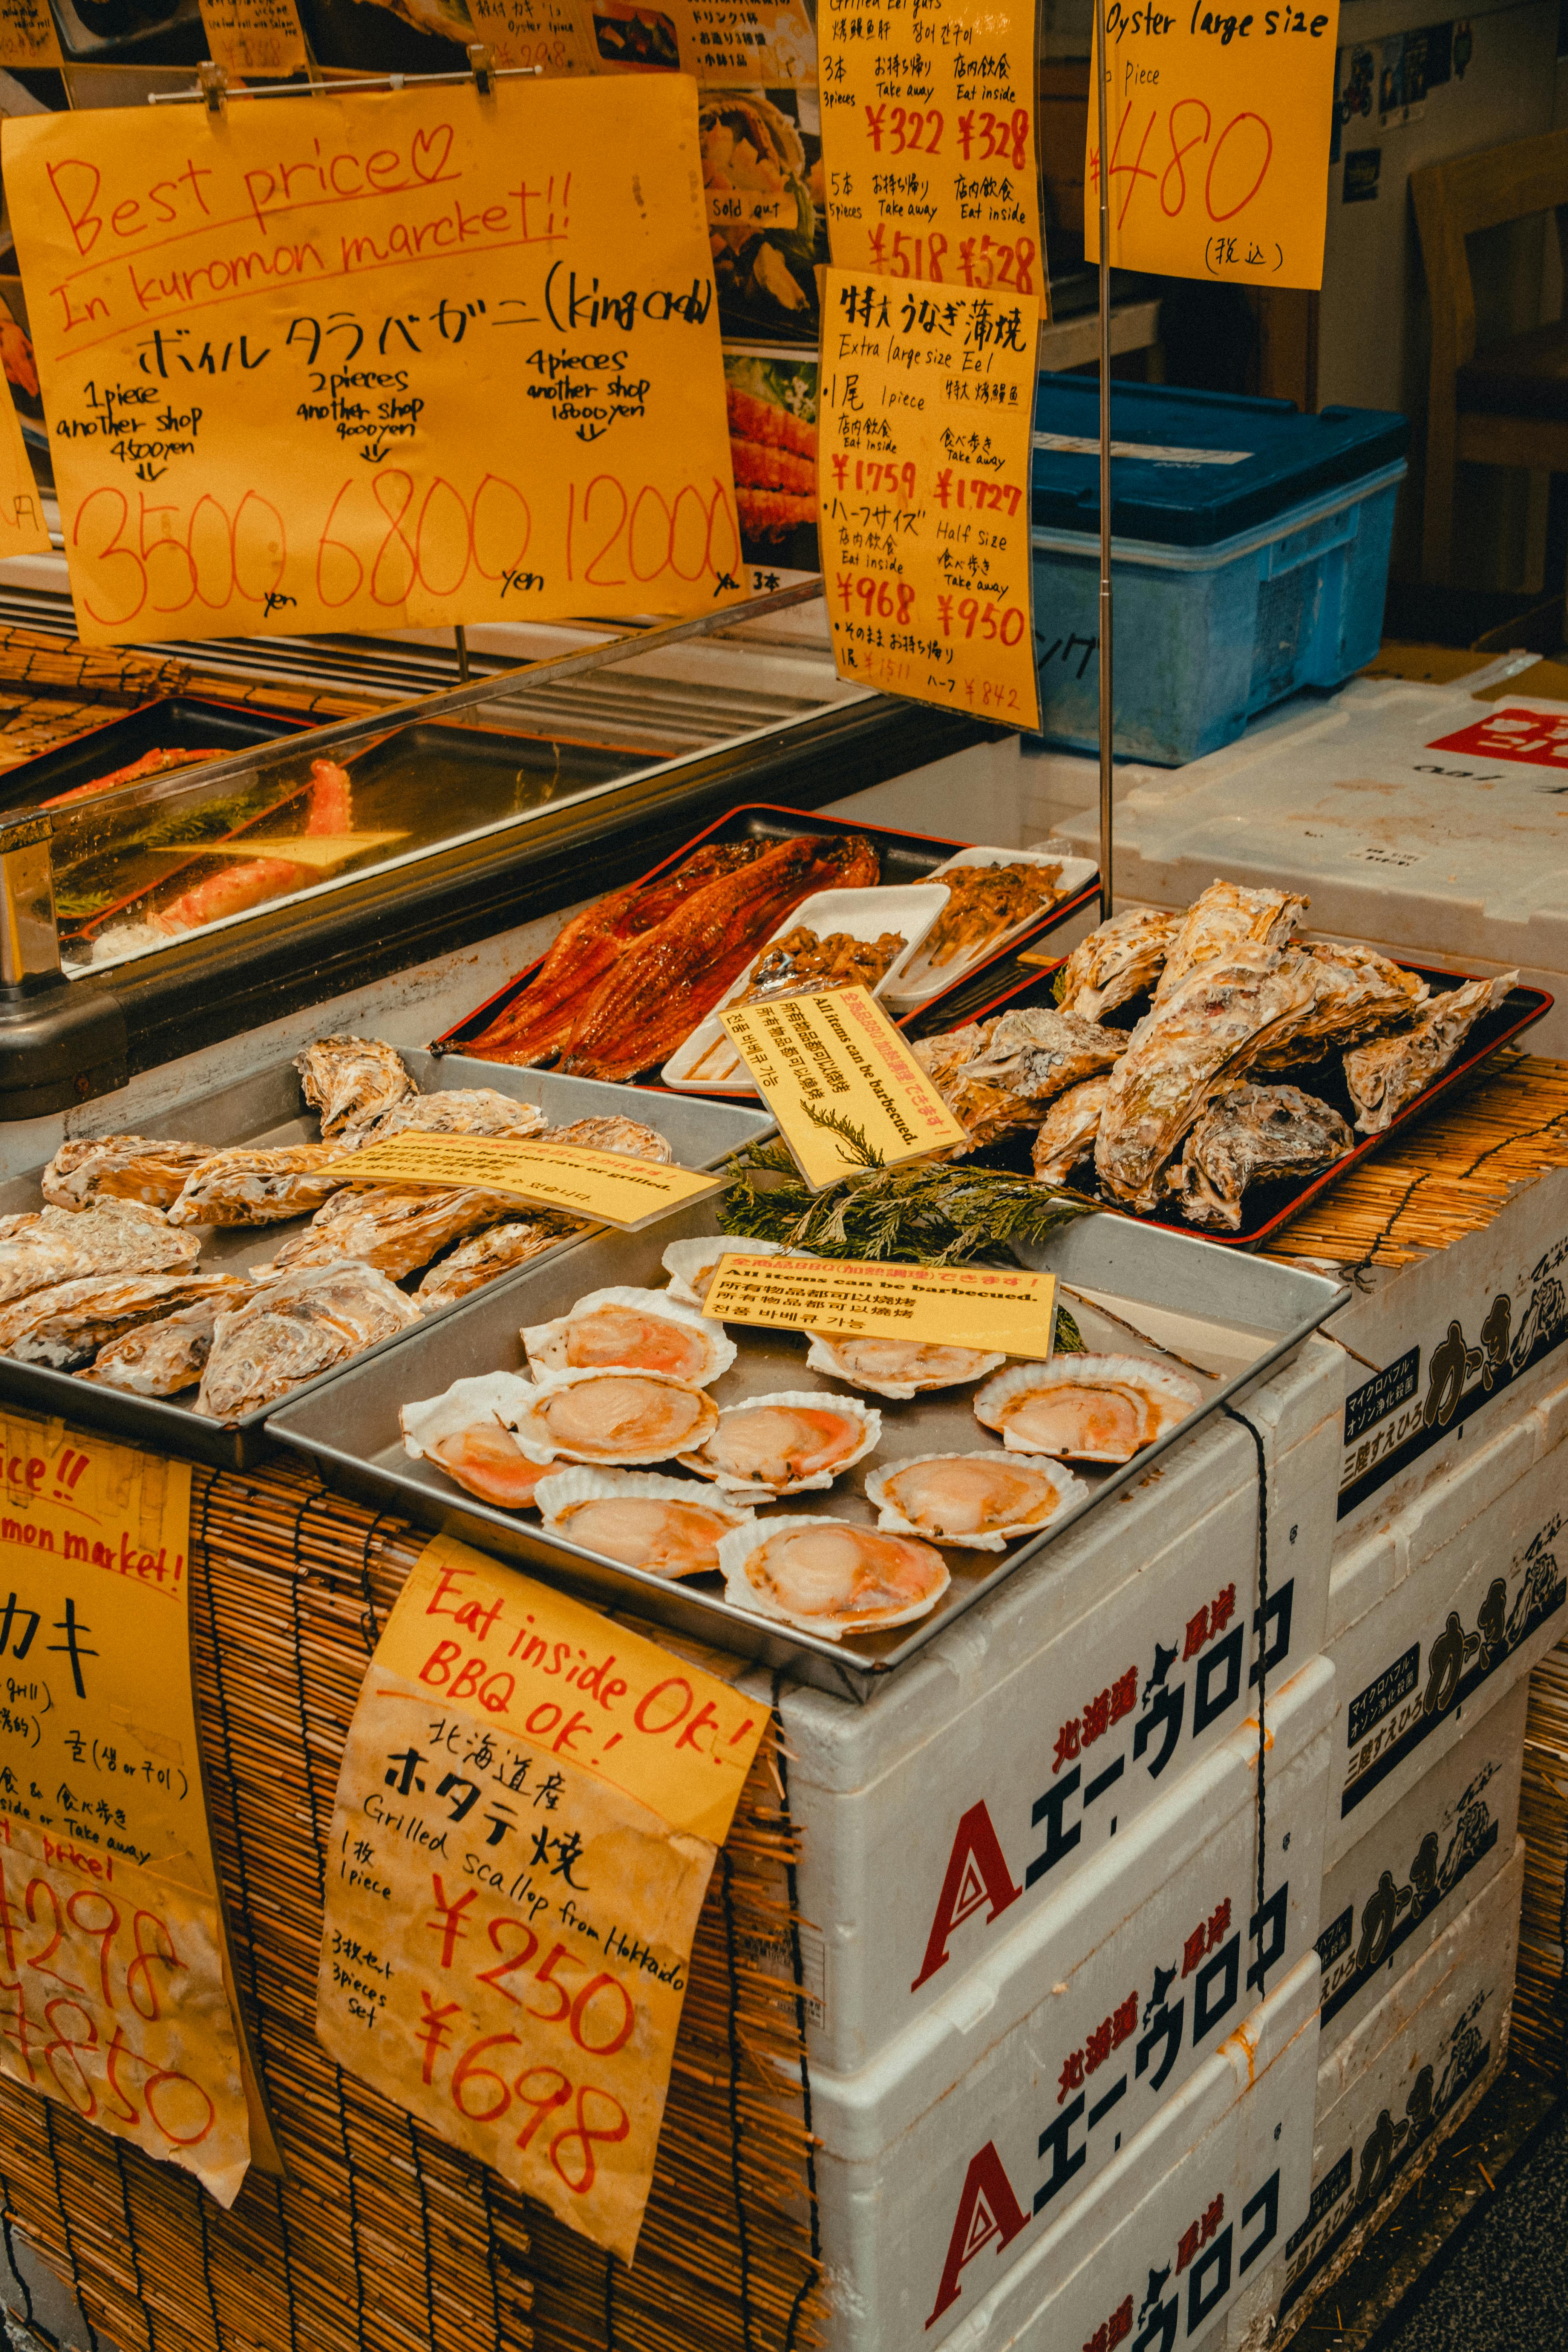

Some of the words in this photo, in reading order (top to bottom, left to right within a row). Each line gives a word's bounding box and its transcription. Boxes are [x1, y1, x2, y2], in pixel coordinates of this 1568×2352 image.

[508, 20, 540, 37] Oyster
[913, 21, 935, 43] 장어
[1106, 1, 1176, 44] Oyster
[1190, 0, 1254, 45] large
[1266, 5, 1329, 38] size
[823, 55, 846, 82] 3本
[875, 54, 931, 78] お持ち帰り
[954, 53, 1011, 79] 店内飲食
[824, 91, 856, 109] 3pieces
[876, 81, 902, 98] Take
[906, 87, 934, 104] away
[957, 85, 977, 100] Eat
[982, 86, 1015, 103] inside
[865, 103, 944, 155] ¥322
[957, 109, 1029, 170] ¥328
[831, 172, 853, 196] 5本
[1089, 98, 1272, 231] ¥480
[46, 159, 212, 256] Best
[244, 138, 400, 235] price
[872, 174, 929, 201] お持ち帰り
[954, 174, 1014, 201] 店内飲食
[712, 198, 741, 217] Sold
[752, 201, 780, 219] out
[829, 202, 862, 221] 5pieces
[878, 200, 903, 217] Take
[908, 204, 938, 223] away
[961, 204, 981, 219] Eat
[989, 204, 1026, 224] inside
[868, 223, 948, 283] ¥518
[957, 234, 1035, 295] ¥528
[1205, 236, 1283, 275] (税込)
[49, 282, 110, 332] In
[129, 243, 324, 310] kuromon
[137, 330, 271, 378] ボイル
[286, 299, 540, 365] タラバガニ
[545, 260, 639, 332] (king
[839, 334, 879, 360] Extra
[888, 335, 920, 369] large
[928, 349, 952, 367] size
[963, 351, 993, 373] Eel
[527, 375, 597, 399] another
[606, 375, 650, 402] shop
[56, 414, 146, 438] another
[157, 406, 203, 436] shop
[297, 397, 370, 424] another
[378, 397, 424, 425] shop
[839, 413, 891, 438] 店内飲食
[844, 438, 861, 448] Eat
[867, 439, 897, 454] inside
[940, 427, 991, 455] 食べ歩き
[948, 450, 970, 463] Take
[977, 456, 1006, 471] away
[316, 469, 531, 608] 6800
[502, 571, 543, 598] yen
[568, 475, 739, 586] 12000
[831, 499, 926, 536] ハーフサイズ
[937, 521, 971, 542] Half
[74, 487, 286, 625] 3500
[264, 591, 297, 617] yen
[839, 527, 897, 556] 店内飲食
[753, 571, 780, 592] 3本
[842, 551, 859, 565] Eat
[867, 557, 903, 574] inside
[938, 548, 989, 577] 食べ歩き
[837, 572, 915, 625] ¥968
[944, 574, 971, 590] Take
[977, 581, 1008, 602] away
[937, 594, 1024, 646] ¥950
[928, 675, 955, 693] ハーフ
[740, 1033, 768, 1064] 바베큐
[760, 1065, 779, 1087] 가능
[813, 997, 827, 1014] All
[827, 1012, 852, 1043] items
[846, 1044, 865, 1065] can
[860, 1064, 874, 1080] be
[870, 1078, 920, 1145] barbecued.
[548, 1159, 584, 1168] raw
[606, 1173, 671, 1191] grilled.
[724, 1269, 759, 1278] All
[764, 1272, 827, 1283] items
[880, 1282, 905, 1290] be
[912, 1284, 1038, 1302] barbecued.
[759, 1309, 819, 1324] 바베큐
[827, 1317, 867, 1329] 가능
[1347, 1376, 1415, 1436] オゾン浄化殺菌
[1340, 1400, 1424, 1487] 三陸すえひろ
[64, 1530, 183, 1592] market!
[0, 1592, 100, 1699] カキ
[425, 1566, 504, 1642] Eat
[507, 1614, 628, 1712] inside
[418, 1639, 516, 1714] BBQ
[1052, 1665, 1138, 1775] 北海道
[1344, 1692, 1423, 1786] 三陸すえひろ
[124, 1763, 135, 1775] or
[429, 1718, 565, 1810] 北海道産
[57, 1782, 126, 1830] 食べ歩き
[384, 1747, 589, 1891] ホタテ焼
[40, 1813, 52, 1825] or
[64, 1818, 99, 1844] Take
[107, 1838, 151, 1867] away
[341, 1830, 375, 1869] 1枚
[363, 1794, 449, 1860] Grilled
[462, 1852, 549, 1920] scallop
[559, 1899, 600, 1941] from
[910, 1798, 1023, 1994] A
[425, 1872, 635, 2056] ¥250
[348, 1997, 377, 2029] set
[1057, 1990, 1139, 2104] 北海道
[415, 1989, 631, 2194] ¥698
[924, 2139, 1032, 2331] A
